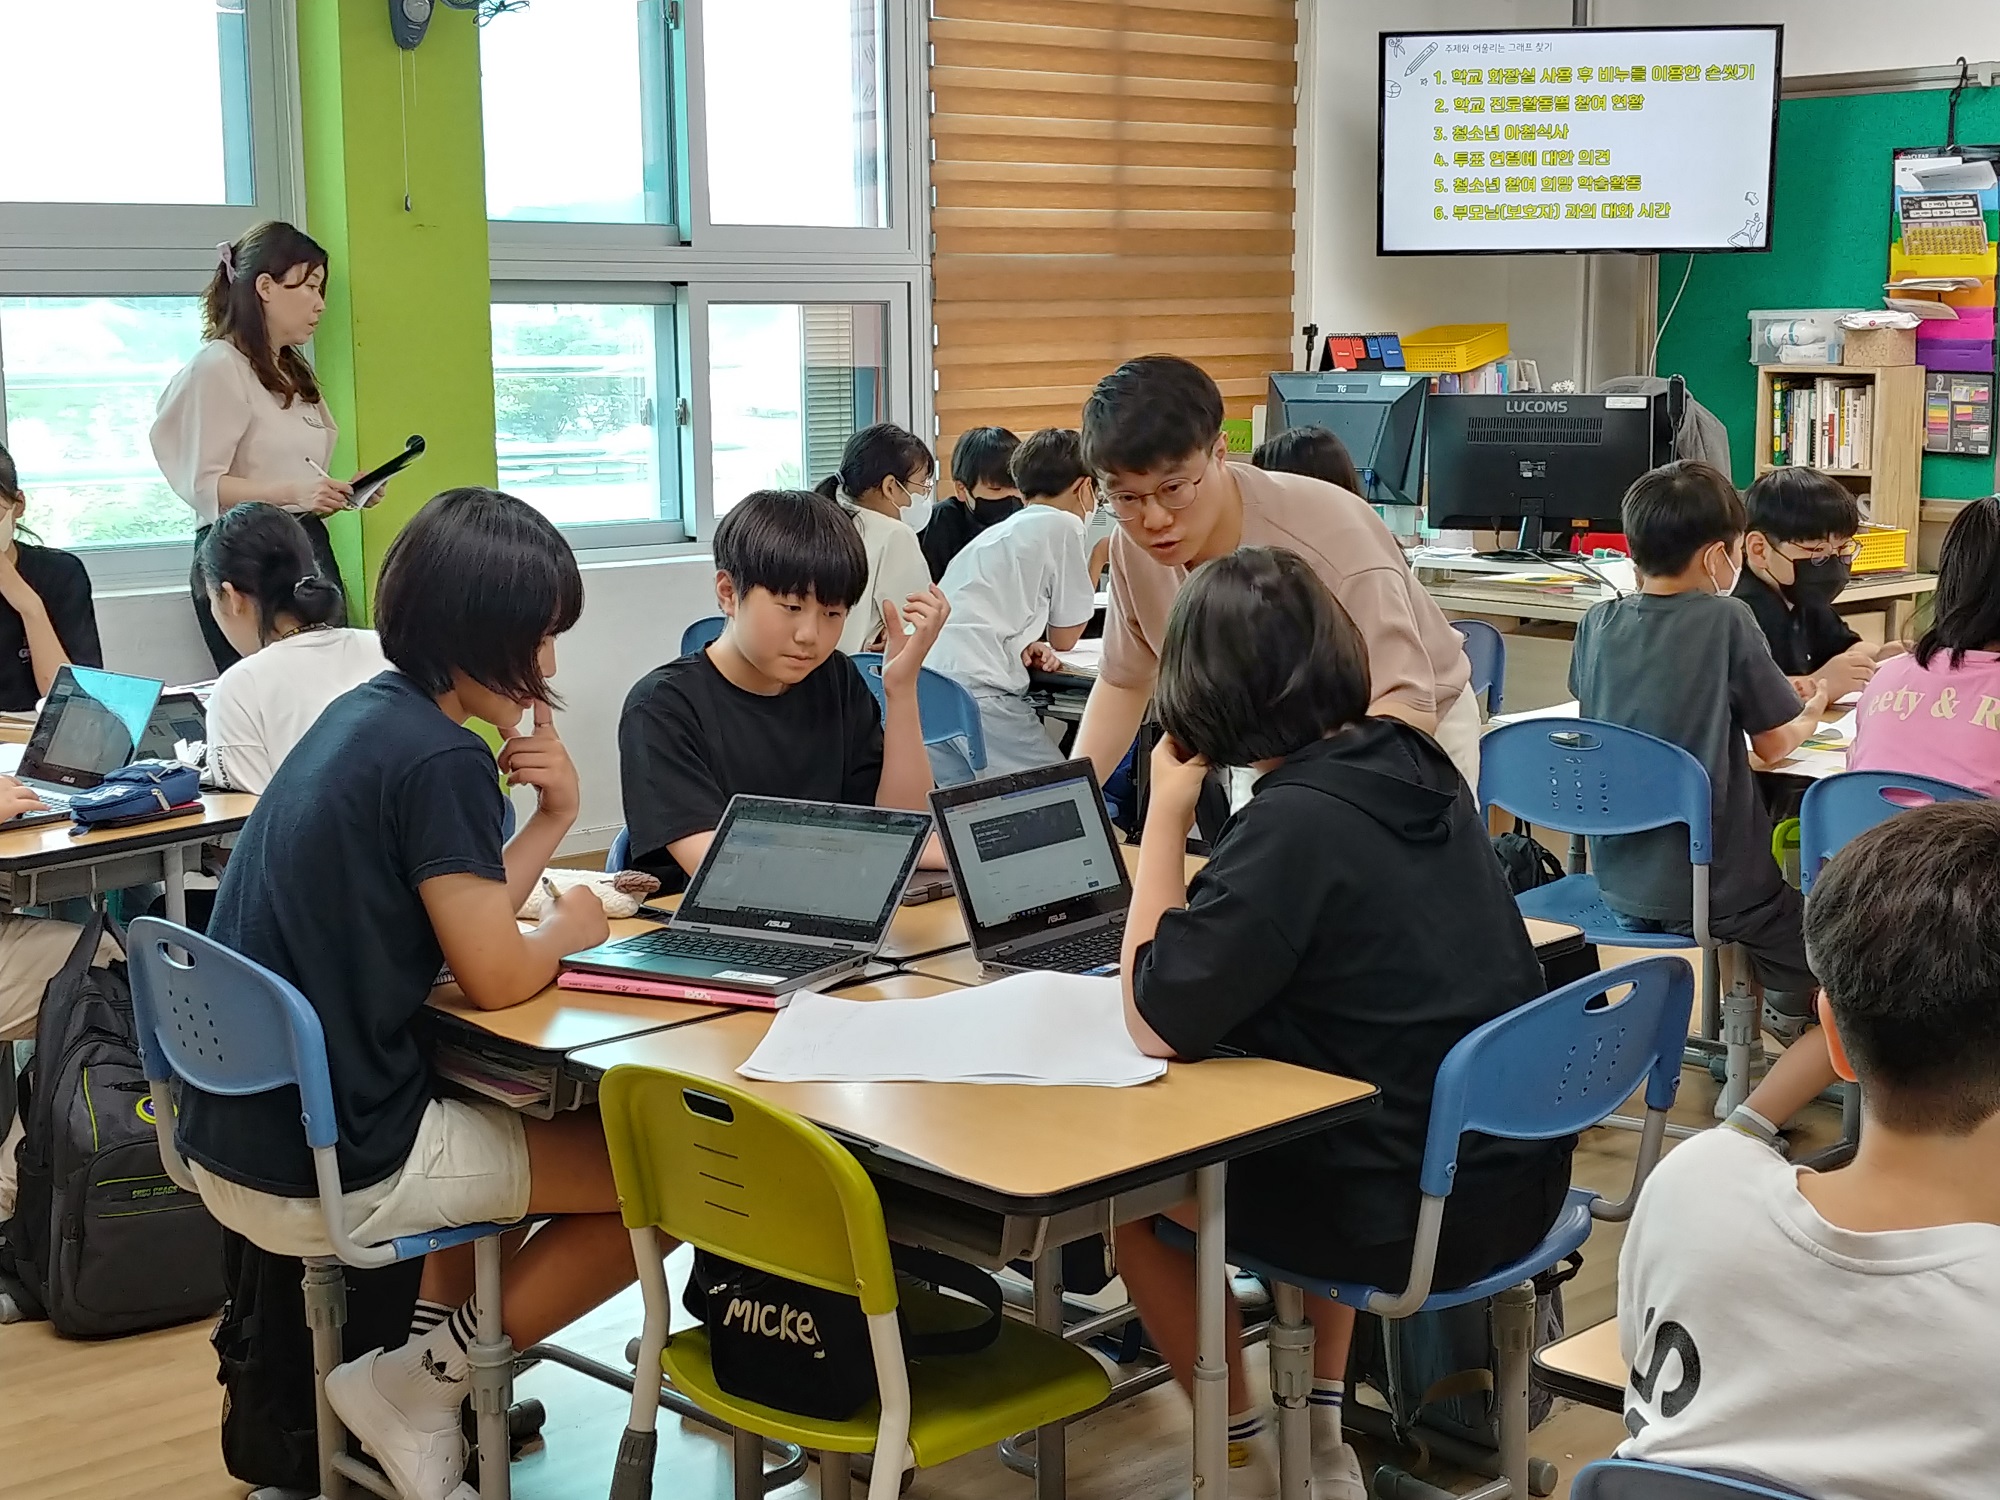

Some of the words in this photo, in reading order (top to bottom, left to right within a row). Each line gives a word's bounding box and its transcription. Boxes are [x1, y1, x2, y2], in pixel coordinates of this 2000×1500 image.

[1445, 44, 1470, 53] 주제와
[1473, 43, 1506, 54] 어울리는
[1508, 43, 1533, 52] 그래프
[1536, 42, 1553, 52] 찾기
[1433, 70, 1447, 85] 1.
[1451, 68, 1483, 85] 학교
[1488, 67, 1536, 85] 화장실
[1540, 66, 1573, 84] 사용
[1577, 66, 1593, 83] 후
[1598, 65, 1647, 82] 비누를
[1651, 64, 1702, 81] 이용한
[1705, 63, 1755, 81] 손씻기
[1434, 98, 1449, 113] 2.
[1453, 96, 1485, 113] 학교
[1490, 95, 1570, 113] 진로활동별
[1575, 94, 1607, 112] 참여
[1611, 93, 1645, 111] 현황
[1433, 126, 1448, 141] 3.
[1452, 124, 1500, 141] 청소년
[1504, 123, 1570, 141] 아침식사
[1433, 153, 1449, 167] 4.
[1453, 151, 1486, 167] 투표
[1489, 150, 1537, 167] 연령에
[1541, 149, 1575, 166] 대한
[1578, 149, 1611, 166] 의견
[1433, 178, 1449, 193] 5.
[1452, 176, 1501, 193] 청소년
[1505, 176, 1537, 193] 참여
[1541, 175, 1575, 192] 희망
[1577, 174, 1642, 192] 학습활동
[1433, 205, 1449, 220] 6.
[1452, 203, 1560, 221] 부모님(보호자)
[1564, 203, 1597, 219] 과의
[1601, 202, 1634, 219] 대화
[1637, 201, 1672, 219] 시간
[1506, 400, 1568, 413] LUCOMS
[1930, 687, 1960, 719] &
[764, 919, 791, 929] ASUS
[1047, 912, 1067, 925] ASUS
